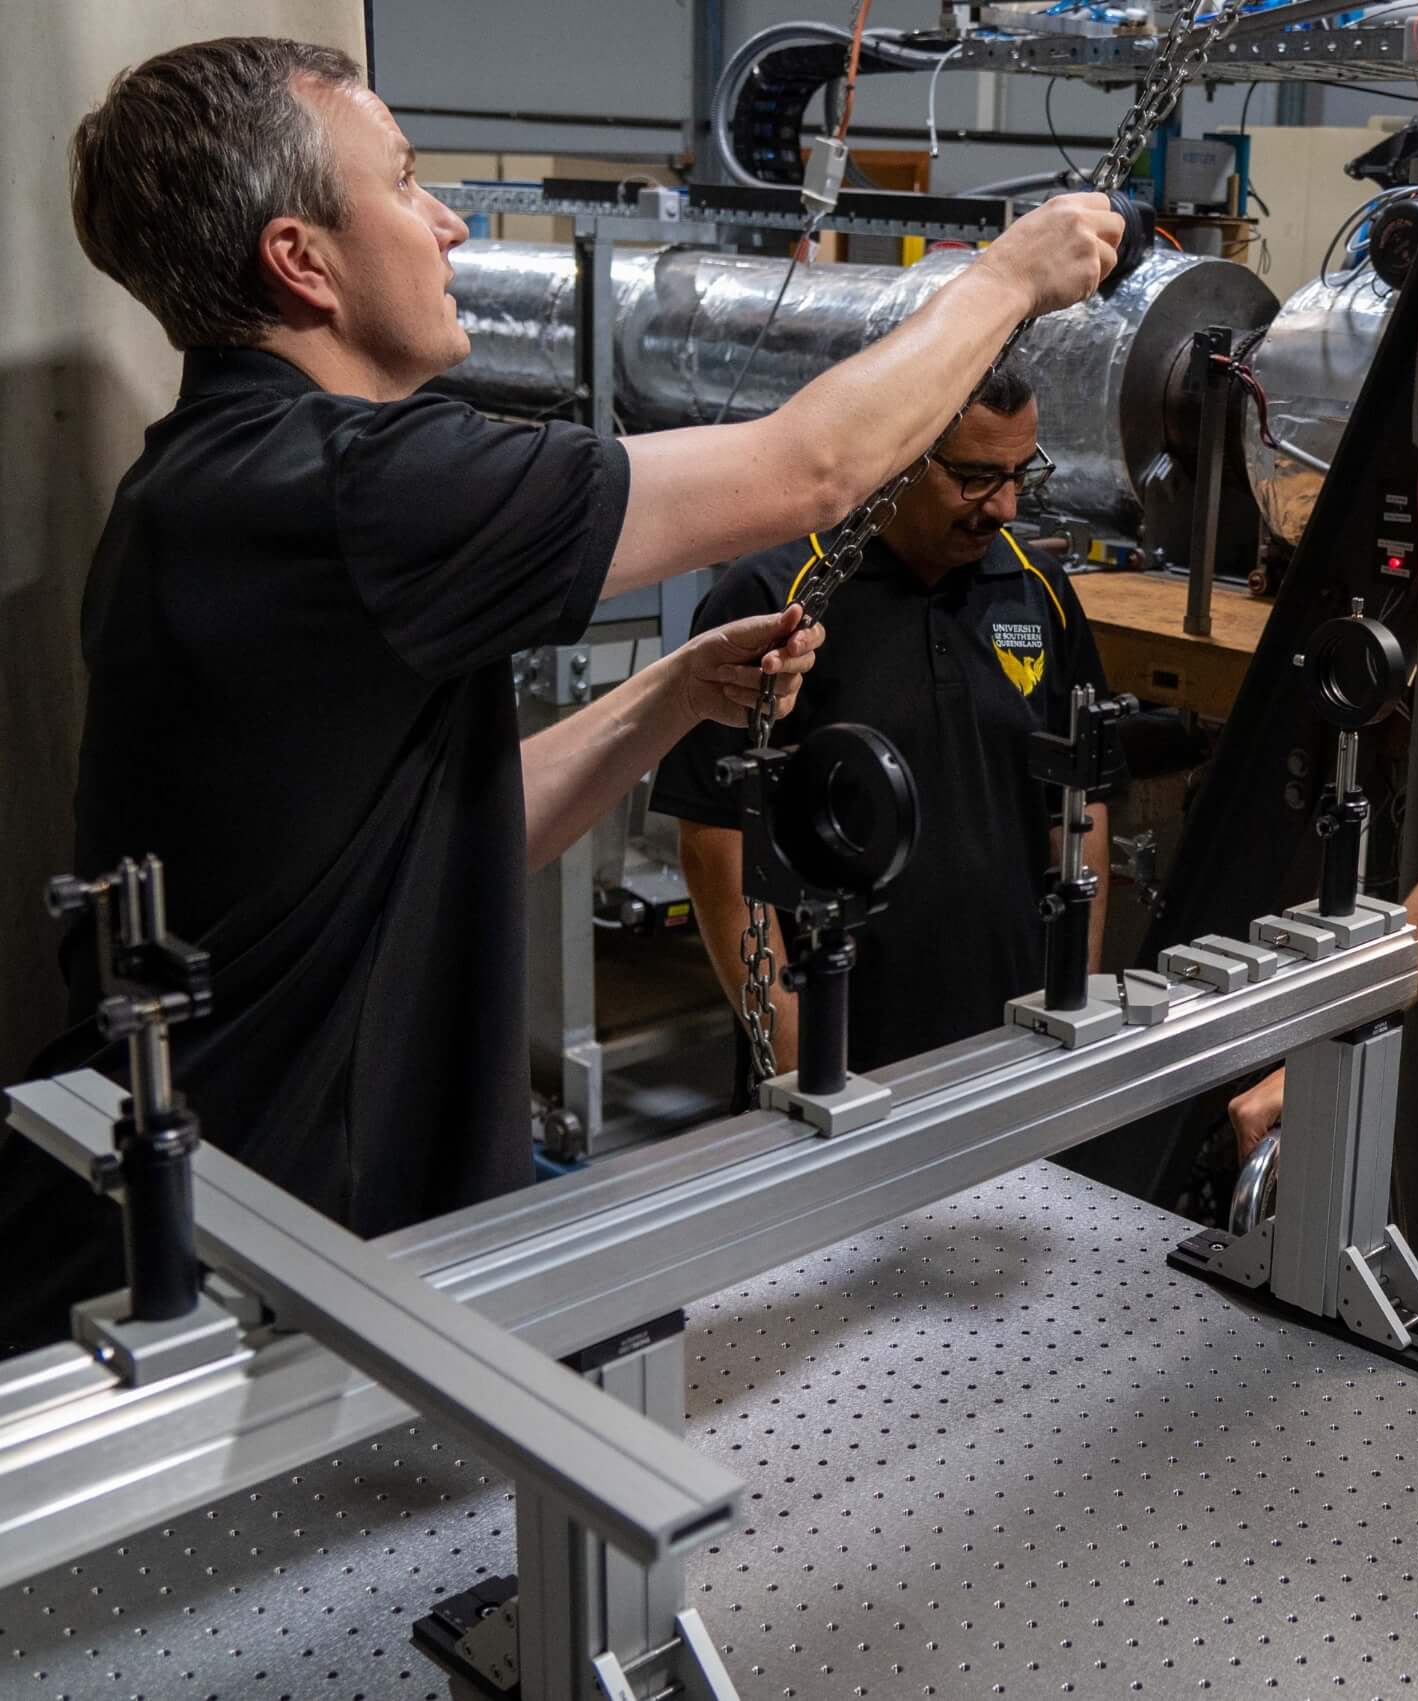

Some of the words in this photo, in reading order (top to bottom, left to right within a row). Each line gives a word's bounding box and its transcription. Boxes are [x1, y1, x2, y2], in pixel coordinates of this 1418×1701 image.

[992, 623, 1041, 633] UNIVERSITY
[1003, 632, 1041, 640] SOUTHERN
[995, 640, 1042, 648] QUEENSLAND
